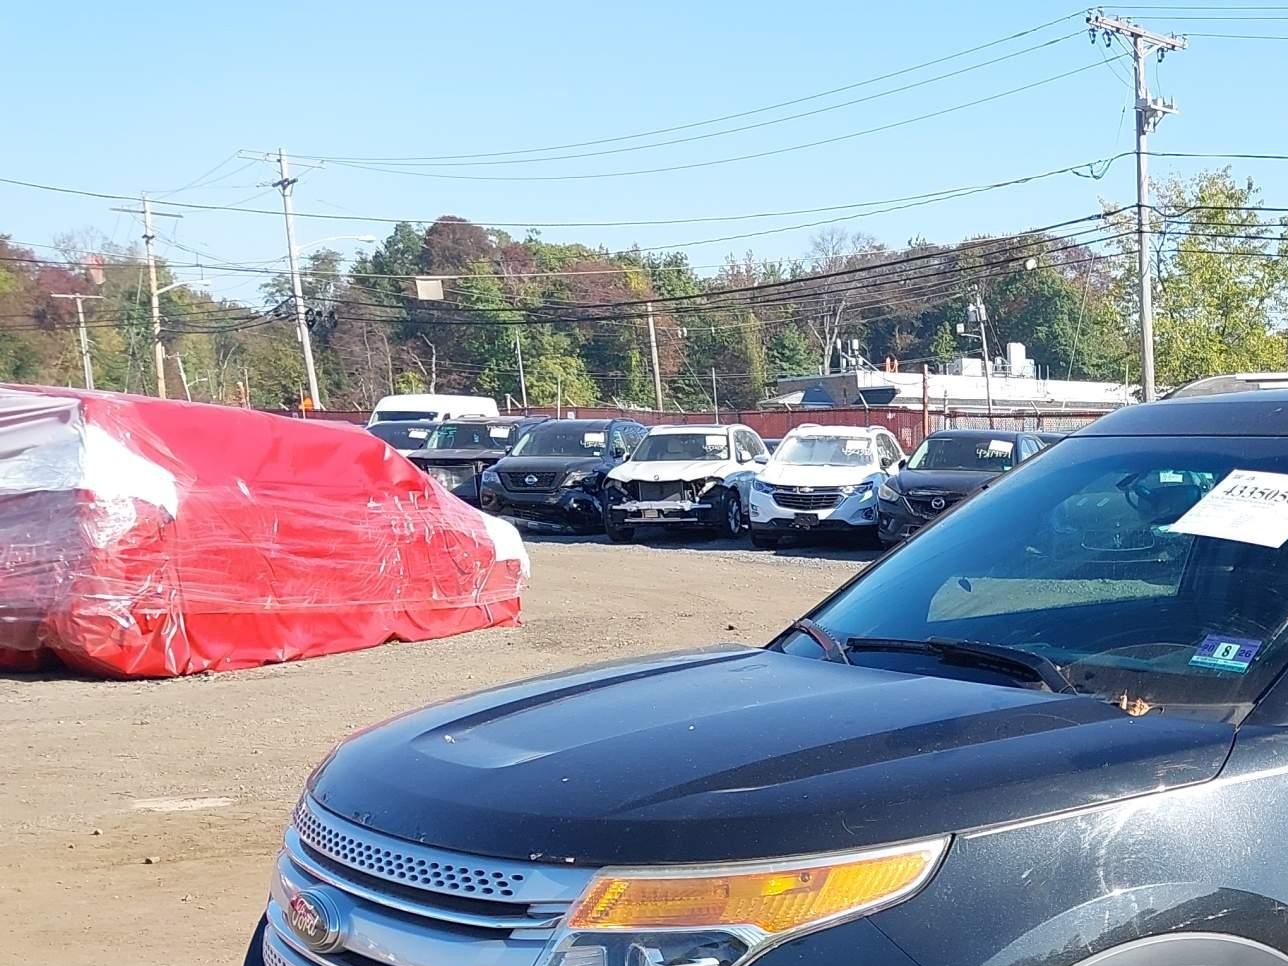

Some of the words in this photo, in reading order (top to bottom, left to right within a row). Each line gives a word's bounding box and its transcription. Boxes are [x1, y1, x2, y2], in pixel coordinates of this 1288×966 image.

[1202, 643, 1215, 653] 20
[1221, 645, 1232, 657] 8
[1239, 649, 1252, 658] 26
[290, 895, 320, 936] Ford
